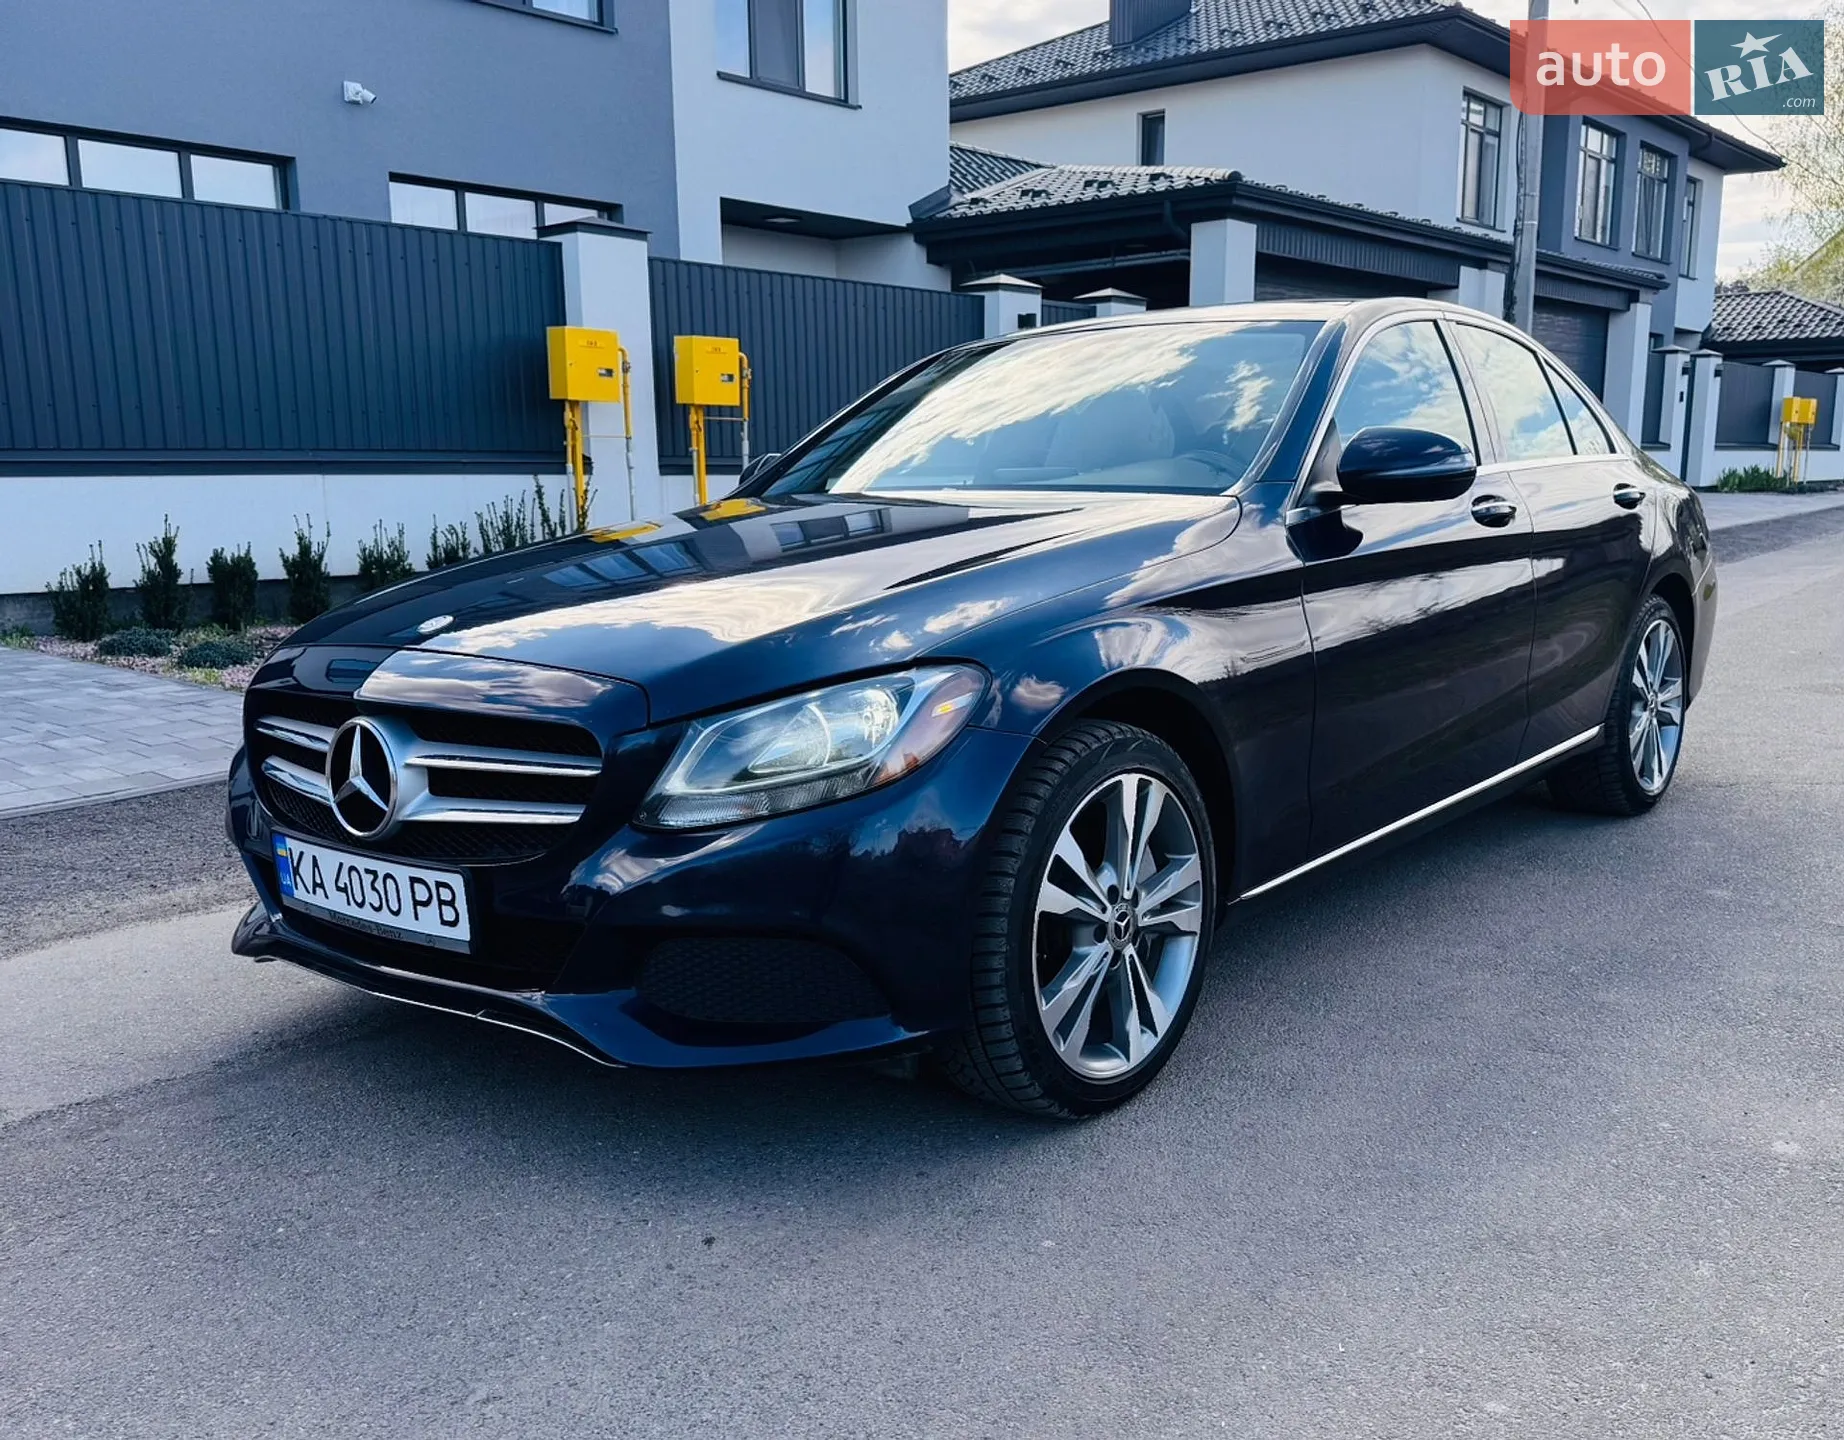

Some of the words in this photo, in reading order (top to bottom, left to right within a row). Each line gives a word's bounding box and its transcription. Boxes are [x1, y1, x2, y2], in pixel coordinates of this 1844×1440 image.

[289, 847, 329, 900] KA
[334, 861, 402, 917] 4030
[408, 875, 460, 928] PB
